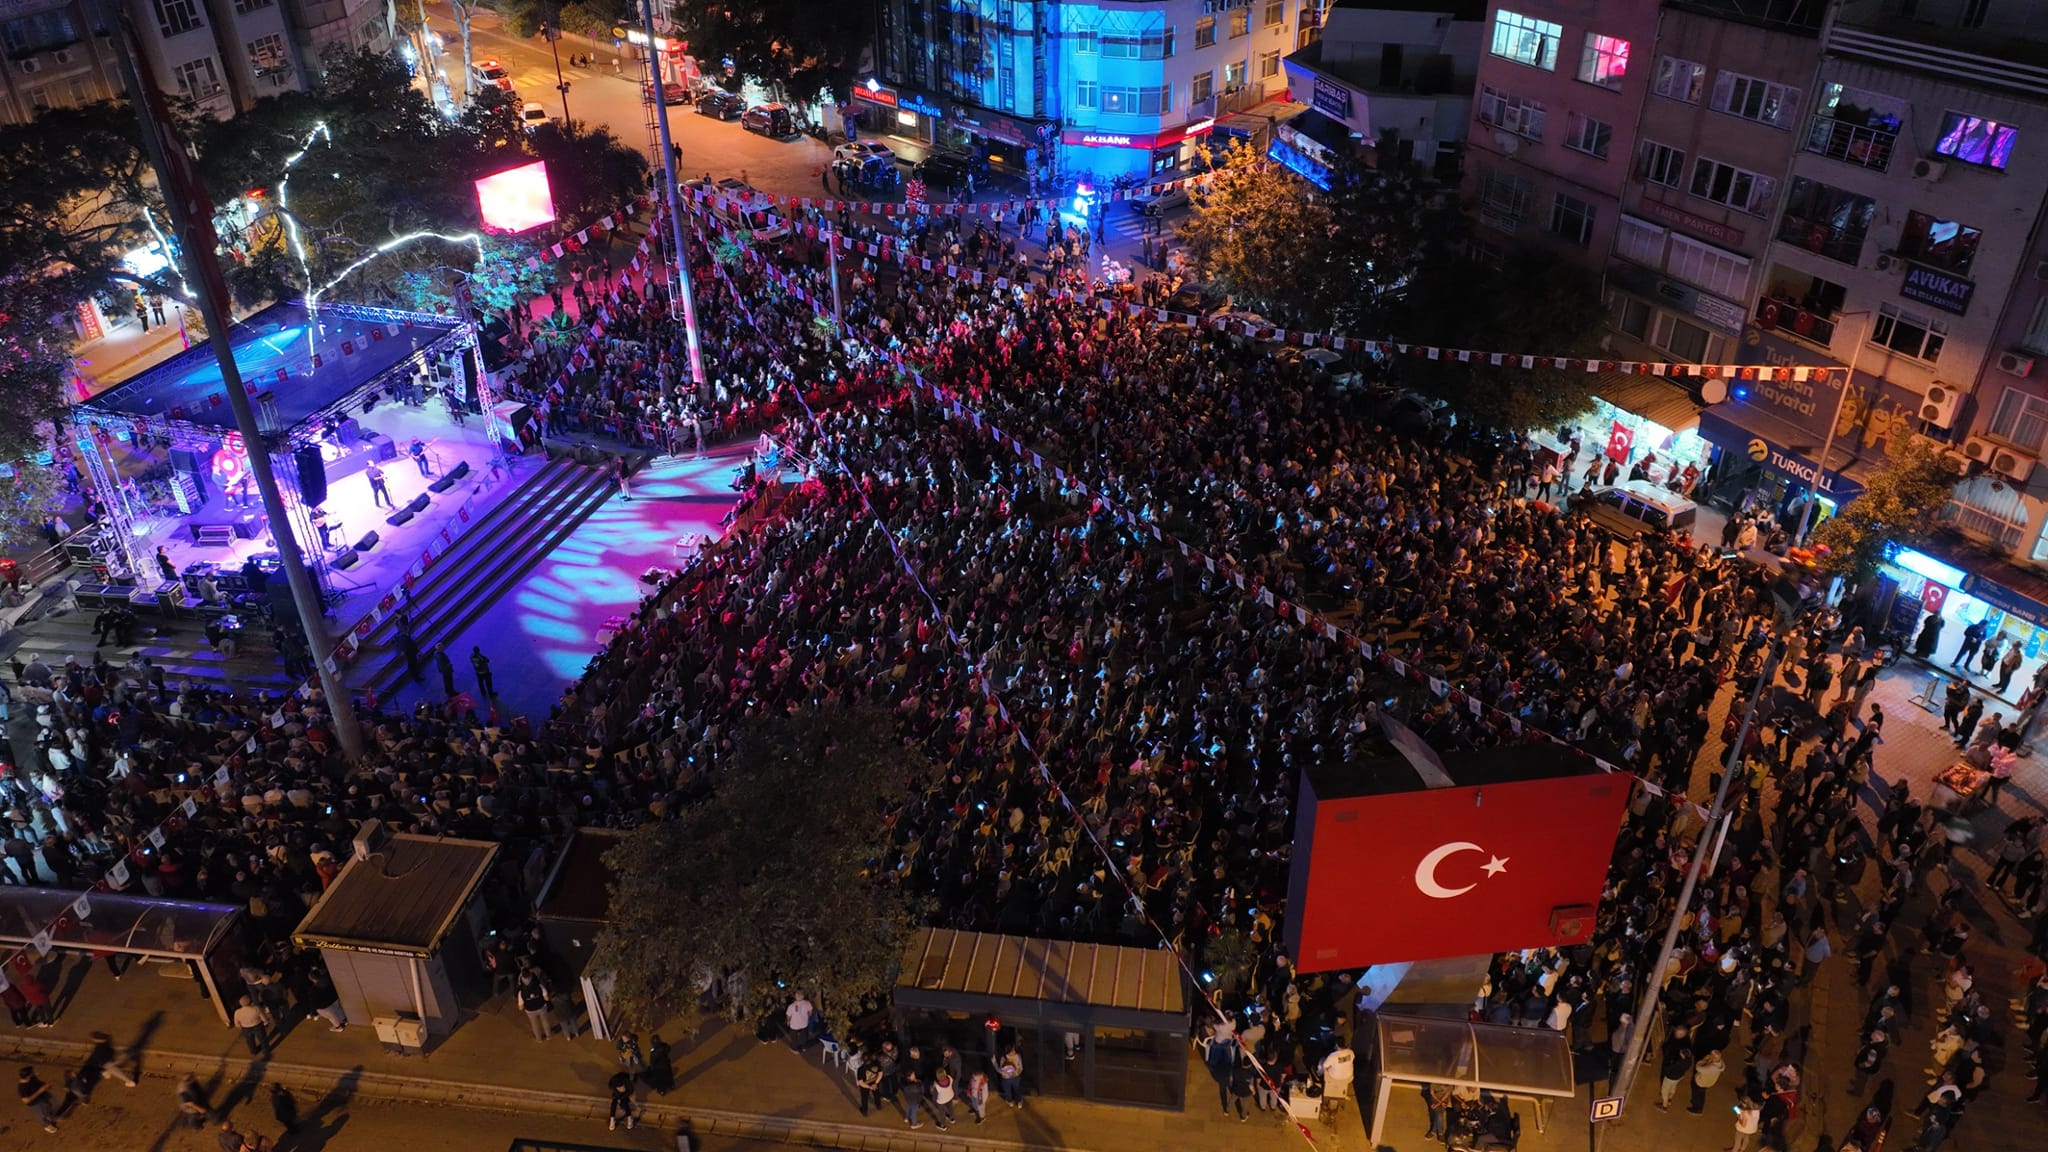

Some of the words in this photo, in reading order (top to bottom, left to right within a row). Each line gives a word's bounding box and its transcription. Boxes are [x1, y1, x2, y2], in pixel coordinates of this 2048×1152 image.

[899, 98, 921, 113] Güneş
[921, 105, 942, 118] Optik
[1083, 135, 1130, 145] AKBANK
[1908, 268, 1970, 299] AVUKAT
[1755, 380, 1817, 417] hayata!
[1600, 1103, 1613, 1115] D
